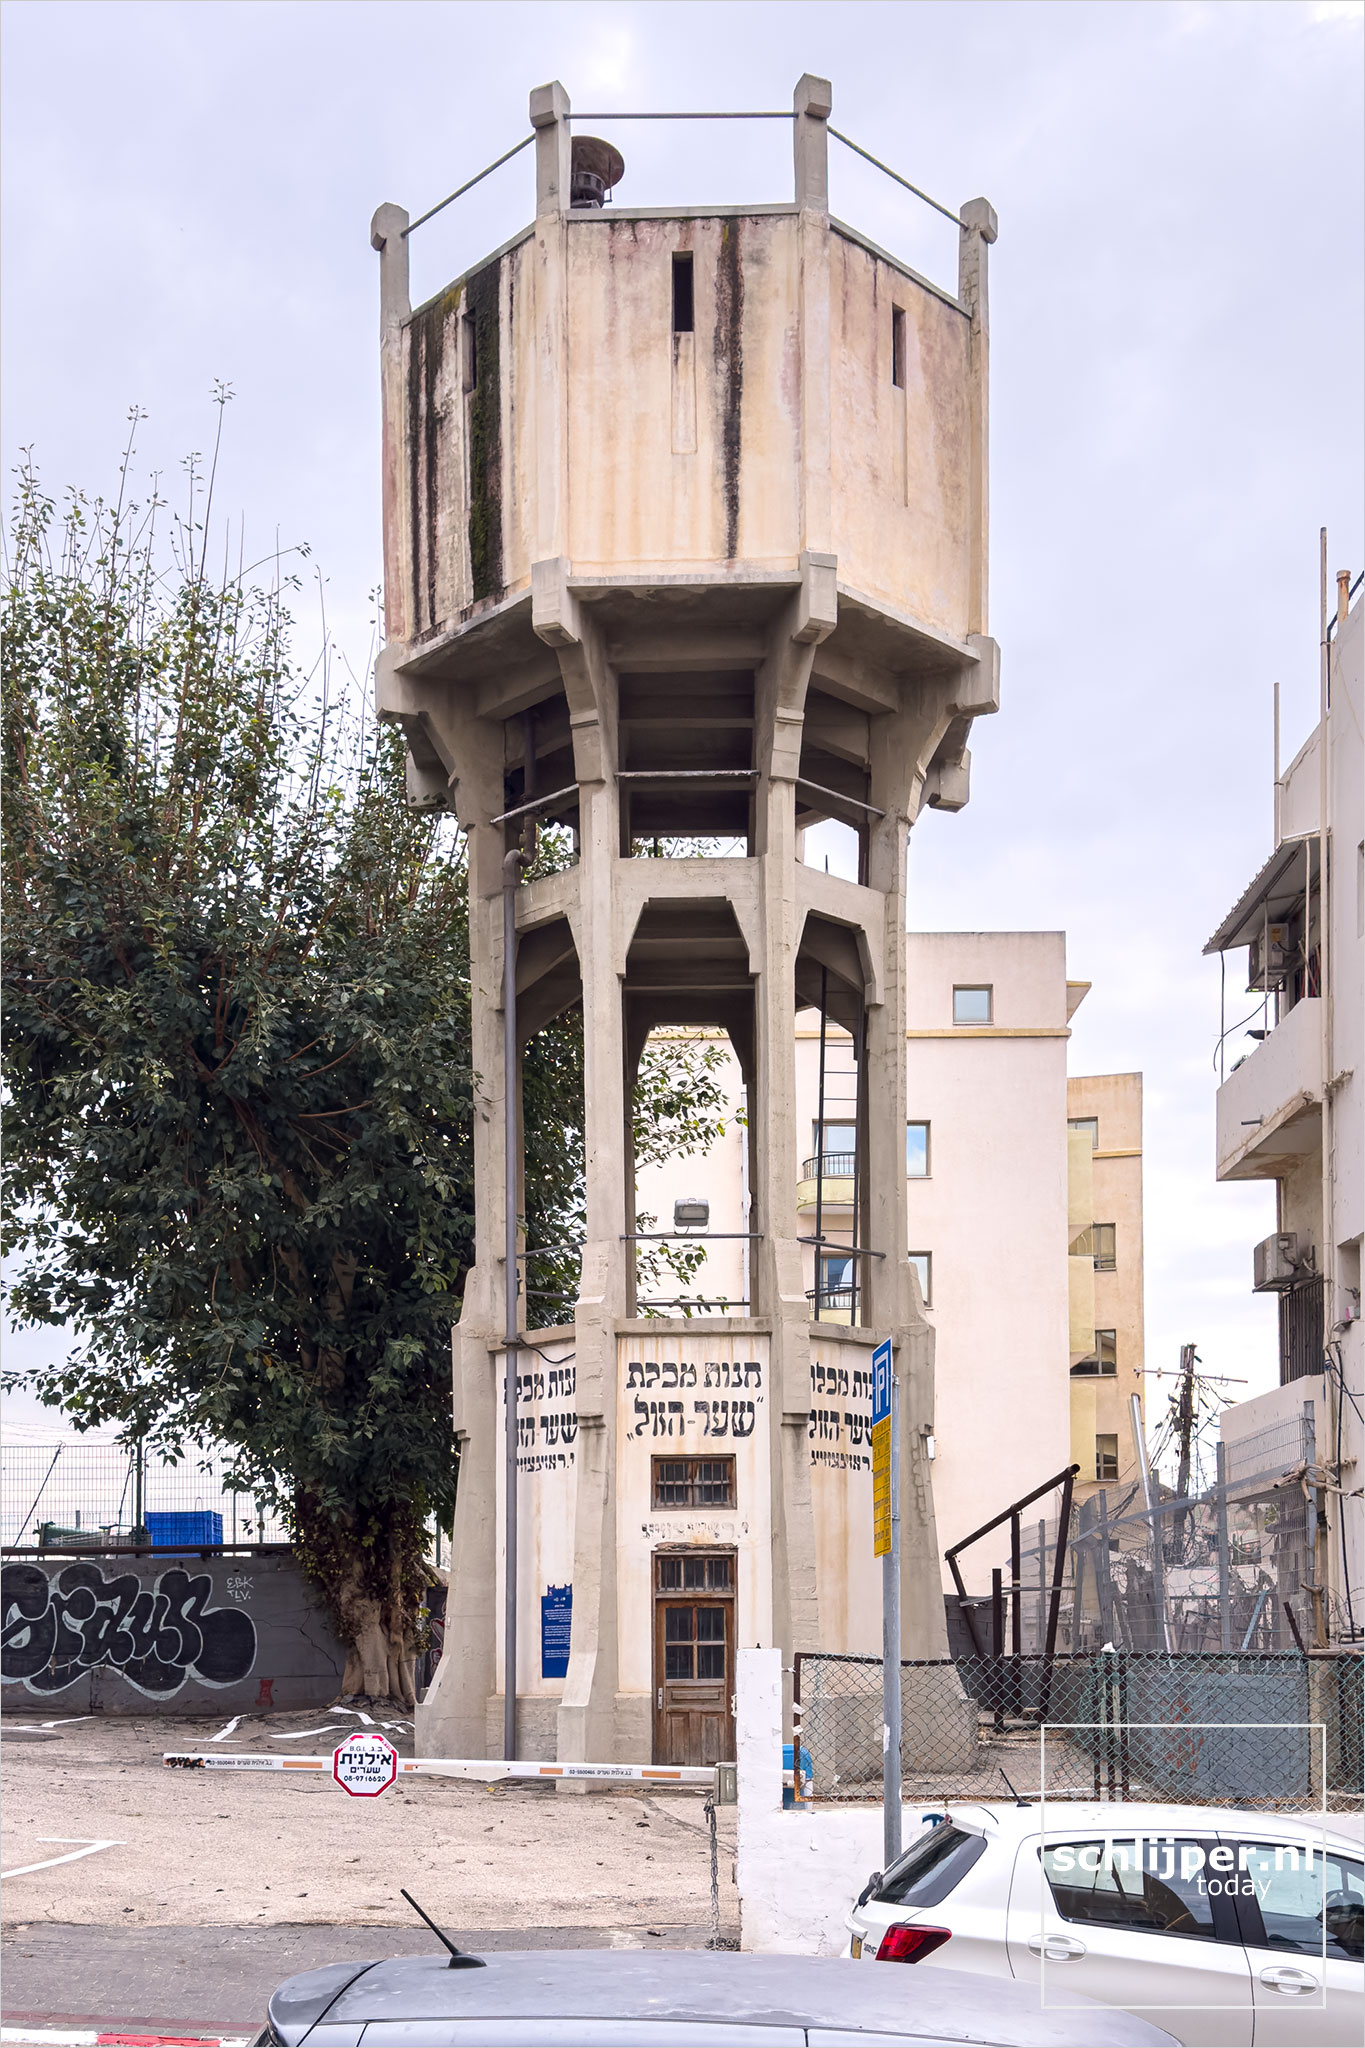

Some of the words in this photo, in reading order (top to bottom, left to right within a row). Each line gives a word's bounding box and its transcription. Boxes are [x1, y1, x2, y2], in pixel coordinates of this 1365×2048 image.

[704, 1362, 762, 1388] חנות
[548, 1367, 576, 1399] נות
[226, 1576, 255, 1589] EBK
[339, 1752, 392, 1765] אילנית
[350, 1766, 381, 1774] שערים
